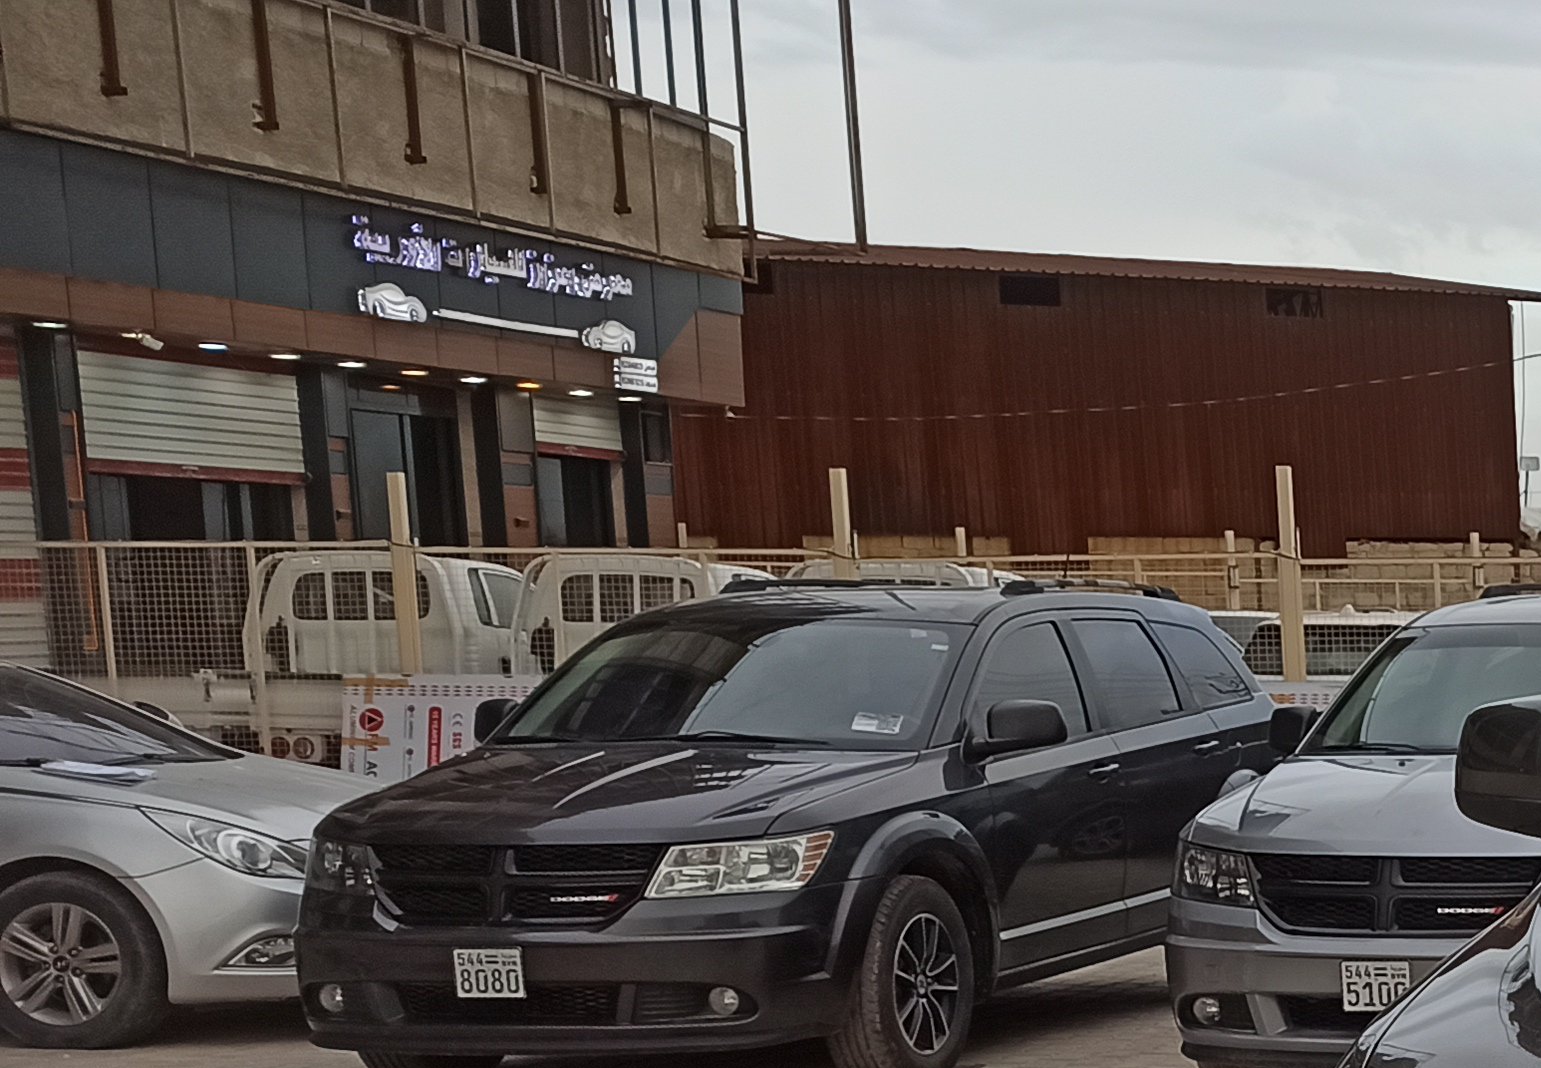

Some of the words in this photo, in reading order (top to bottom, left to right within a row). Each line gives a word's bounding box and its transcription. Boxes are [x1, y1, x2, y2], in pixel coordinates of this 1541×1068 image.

[457, 953, 484, 966] 544
[1345, 965, 1372, 979] 544
[460, 969, 520, 993] 8080
